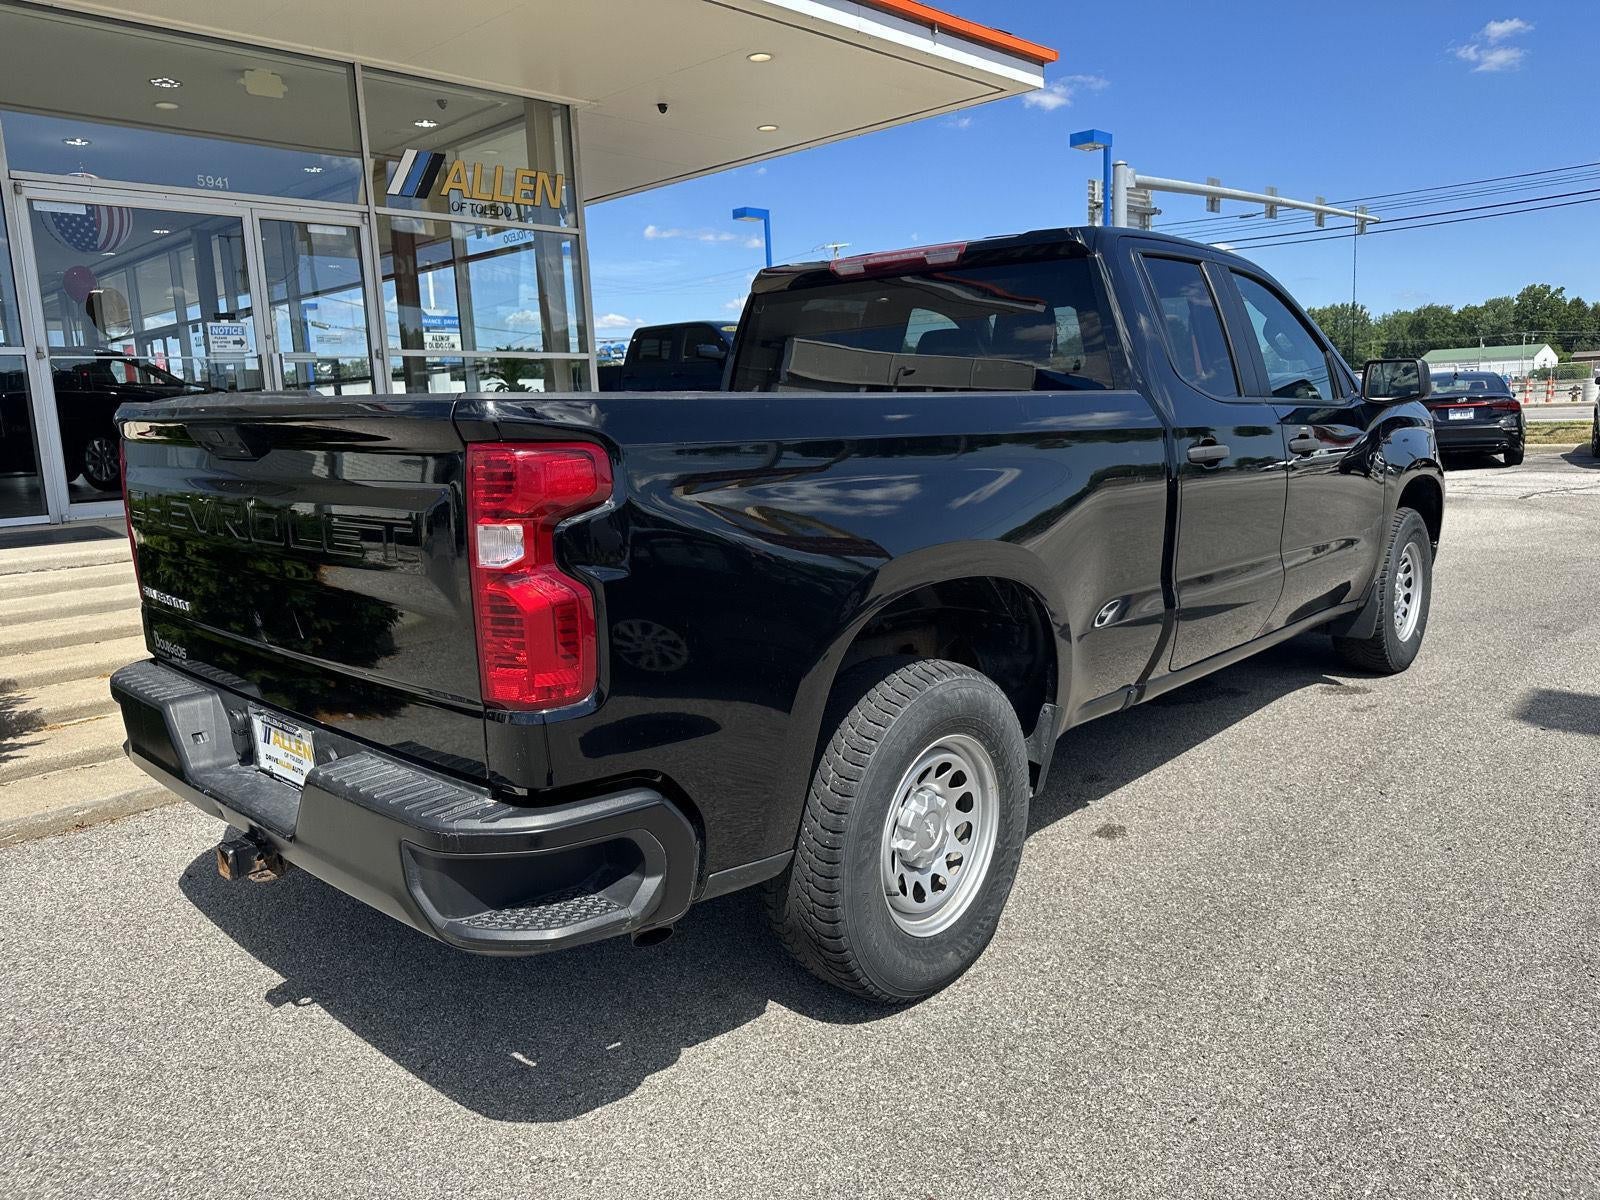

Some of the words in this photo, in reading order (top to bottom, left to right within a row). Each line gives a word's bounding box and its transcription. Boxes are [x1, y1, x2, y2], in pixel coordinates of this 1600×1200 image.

[197, 174, 229, 190] 5941
[440, 160, 564, 209] ALLEN
[451, 200, 467, 212] OF
[469, 202, 512, 217] TOLEDO
[212, 326, 243, 335] NOTICE
[129, 489, 416, 561] CHEVROLET
[272, 729, 312, 762] ALLEN
[290, 754, 304, 766] TOLEDO
